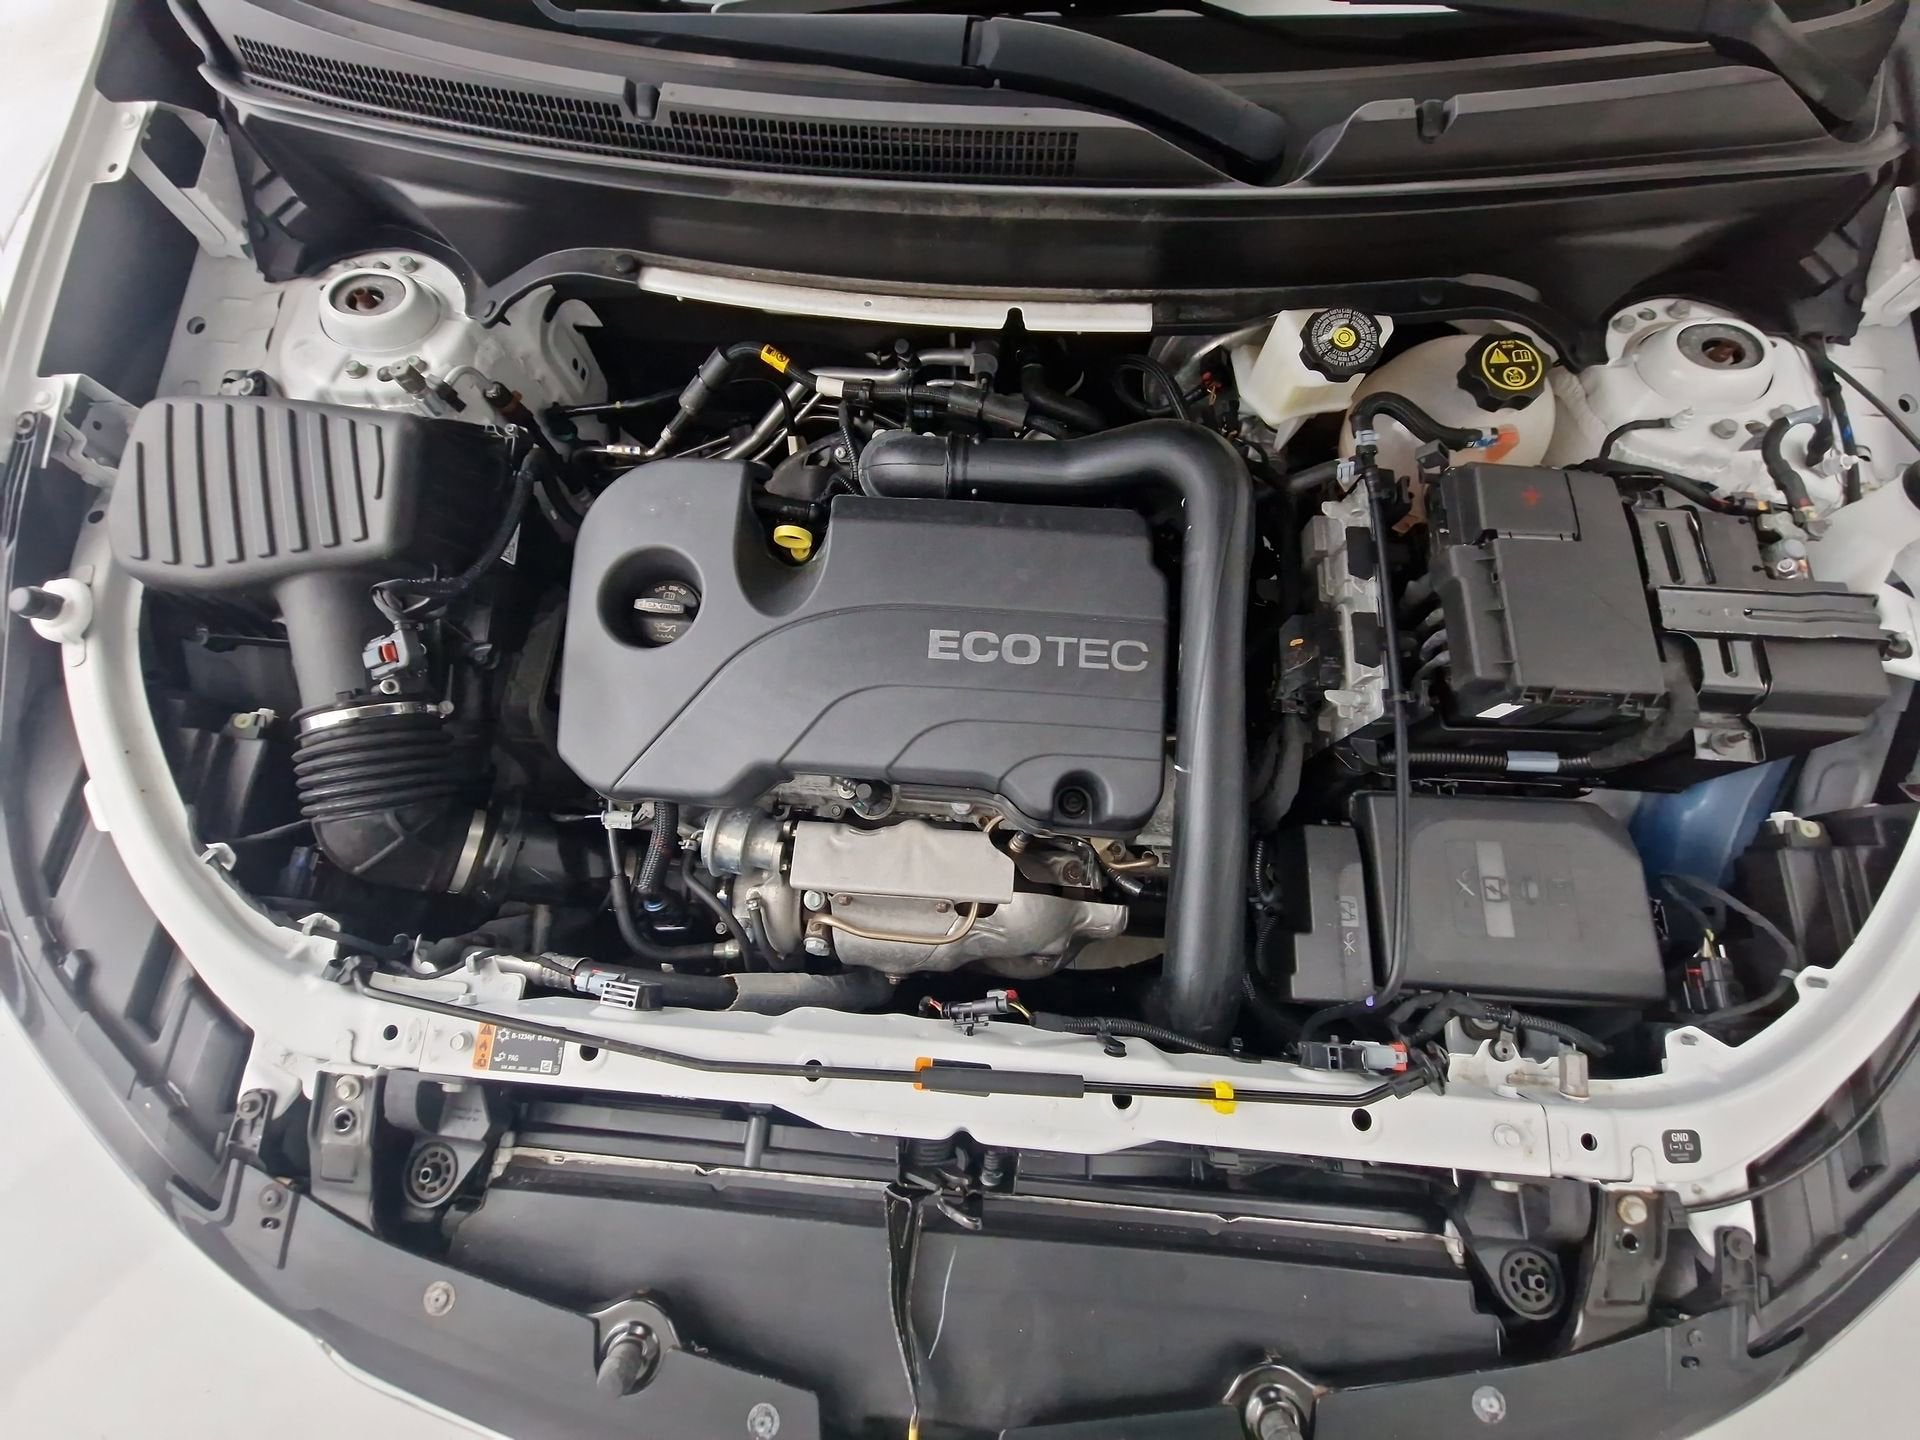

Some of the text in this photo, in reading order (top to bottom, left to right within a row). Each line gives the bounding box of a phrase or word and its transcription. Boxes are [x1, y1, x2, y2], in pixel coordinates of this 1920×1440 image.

[927, 628, 1149, 672] ECOTEC
[507, 1054, 519, 1062] PAG
[1671, 1132, 1689, 1142] GND
